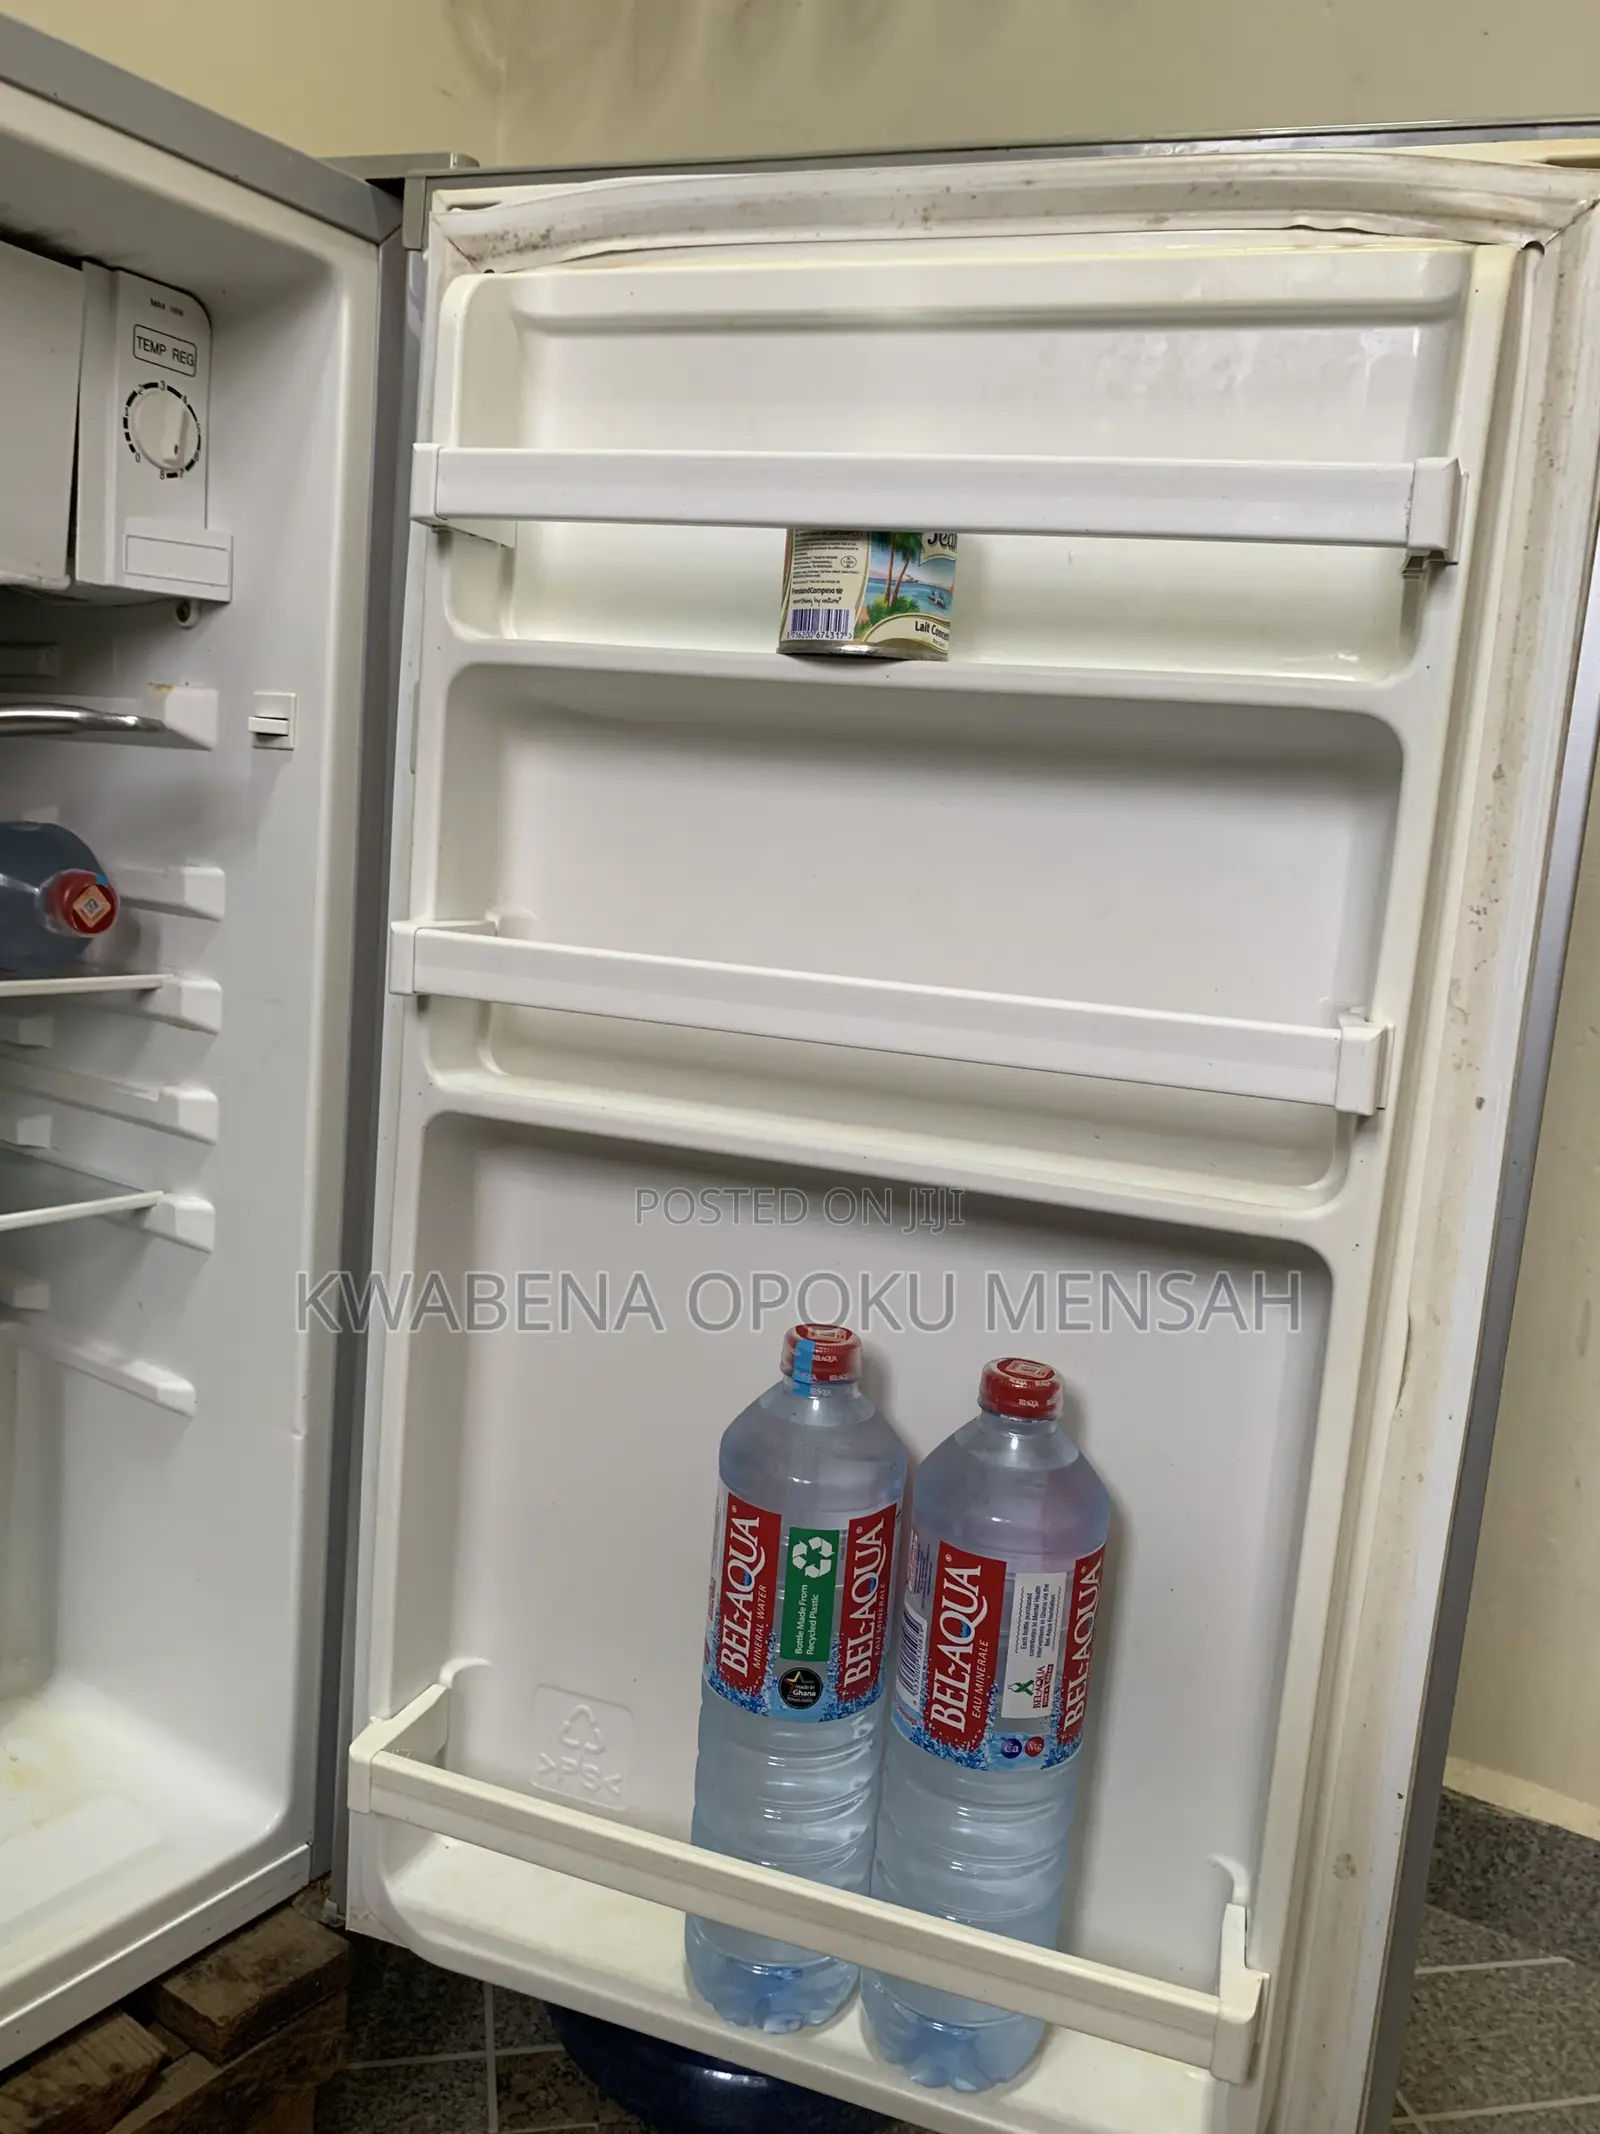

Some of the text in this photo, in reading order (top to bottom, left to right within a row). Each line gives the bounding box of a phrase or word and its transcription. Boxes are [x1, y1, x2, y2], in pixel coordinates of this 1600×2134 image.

[136, 336, 195, 367] TEMP REG
[138, 383, 144, 395] 2
[159, 380, 166, 391] 3
[135, 453, 141, 463] 0
[914, 620, 930, 635] Lait
[795, 1584, 808, 1655] Bottle Made From
[876, 1584, 886, 1635] MINERALE
[1020, 1593, 1032, 1650] Each bottle purchased
[1040, 1602, 1048, 1619] Ghana
[1046, 1594, 1056, 1622] Foundation
[752, 1584, 767, 1669] MINERAL WATER
[806, 1594, 819, 1655] Recycled Plastic
[1029, 1628, 1037, 1657] contributes
[792, 1689, 816, 1697] Ghana
[971, 1639, 989, 1719] EAU MINERALE
[1004, 1741, 1042, 1753] Ca Mg
